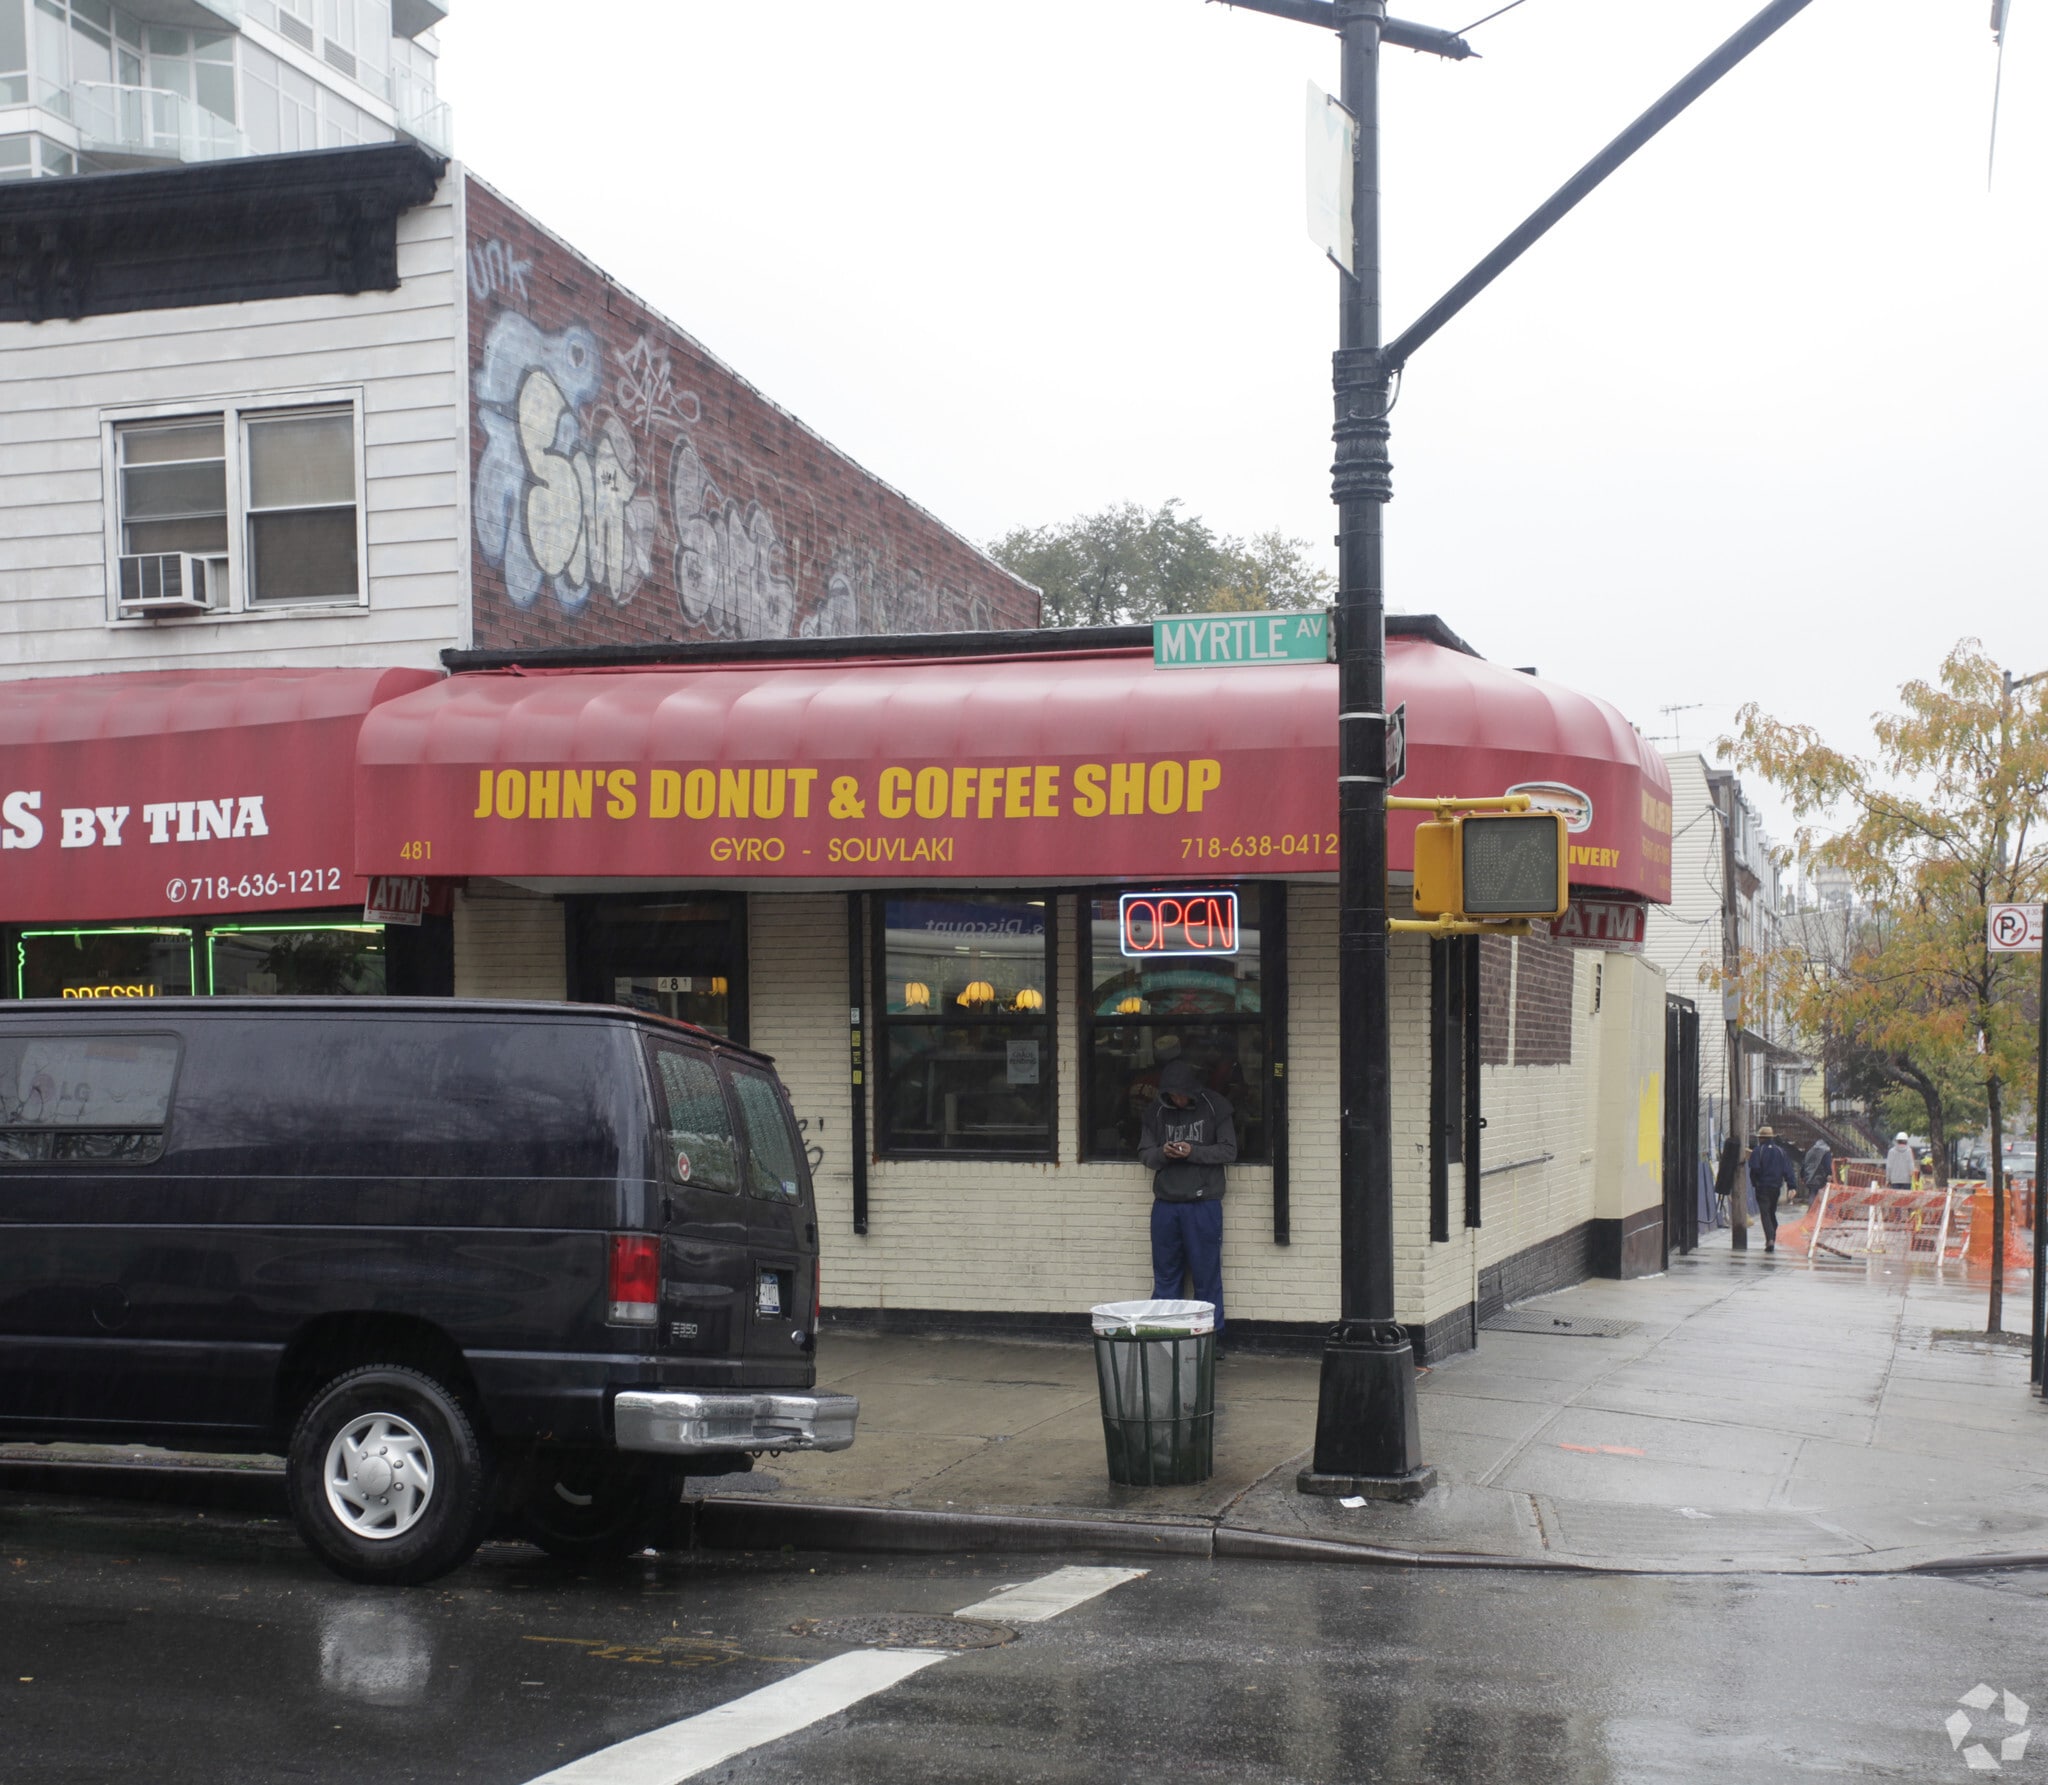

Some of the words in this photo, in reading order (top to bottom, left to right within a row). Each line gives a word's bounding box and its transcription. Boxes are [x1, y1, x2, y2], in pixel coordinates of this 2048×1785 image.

[1162, 618, 1288, 662] MYRTLE
[1296, 617, 1323, 638] AV
[474, 769, 637, 819] JOHN'S
[650, 768, 818, 819] DONUT
[829, 776, 865, 819] &
[879, 766, 1060, 818] COFFEE
[1073, 759, 1221, 817] SHOP
[61, 805, 129, 848] BY
[143, 795, 269, 844] TINA
[400, 841, 432, 859] 481
[710, 837, 785, 862] GYRO
[828, 837, 954, 862] SOUVLAKI
[1181, 834, 1338, 858] 718-638-0412
[1569, 845, 1620, 868] IVERY
[191, 867, 341, 900] 718-636-1212
[373, 876, 419, 911] ATM
[1126, 898, 1232, 950] OPEN
[1560, 902, 1636, 940] ATM
